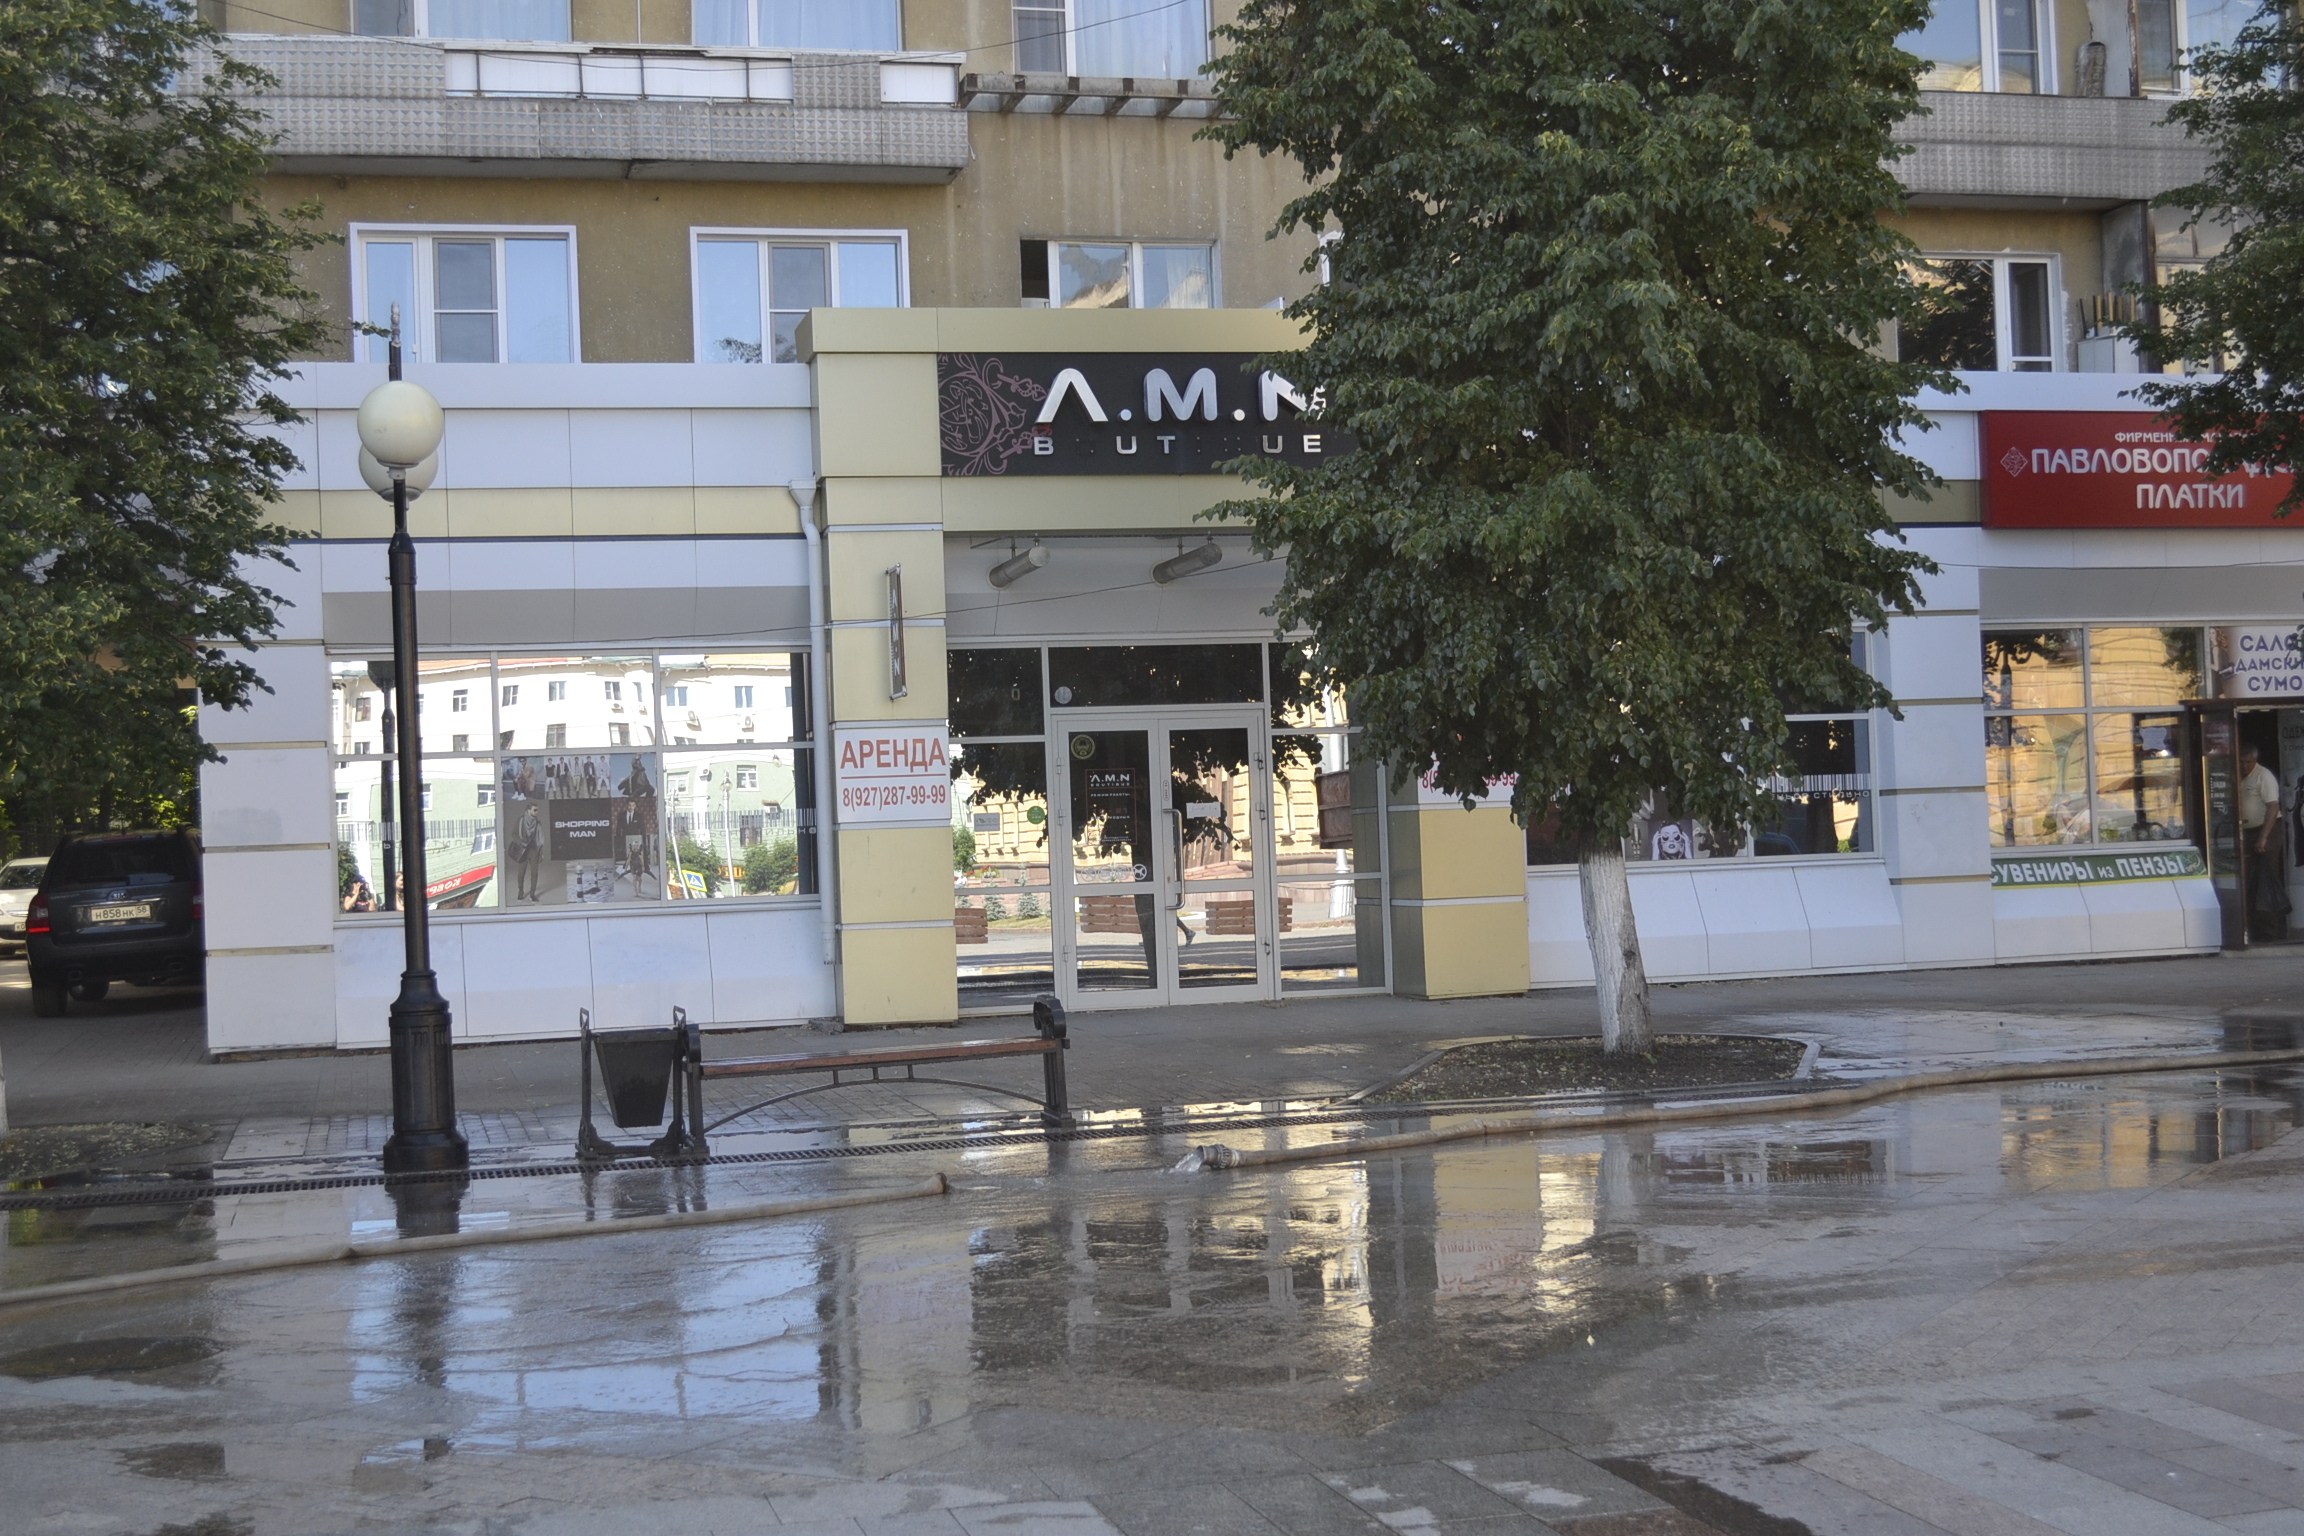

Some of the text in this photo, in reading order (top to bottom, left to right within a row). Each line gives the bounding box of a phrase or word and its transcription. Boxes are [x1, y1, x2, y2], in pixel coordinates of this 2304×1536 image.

[2136, 483, 2244, 509] ПЛАТКИ
[840, 737, 946, 773] АРЕНДА
[842, 783, 947, 812] 8(927)287-99-99
[554, 819, 610, 829] SHOPPING
[569, 830, 597, 839] MAN
[2115, 855, 2187, 878] ПЕНЗЫ
[95, 904, 147, 920] Н858НК 58
